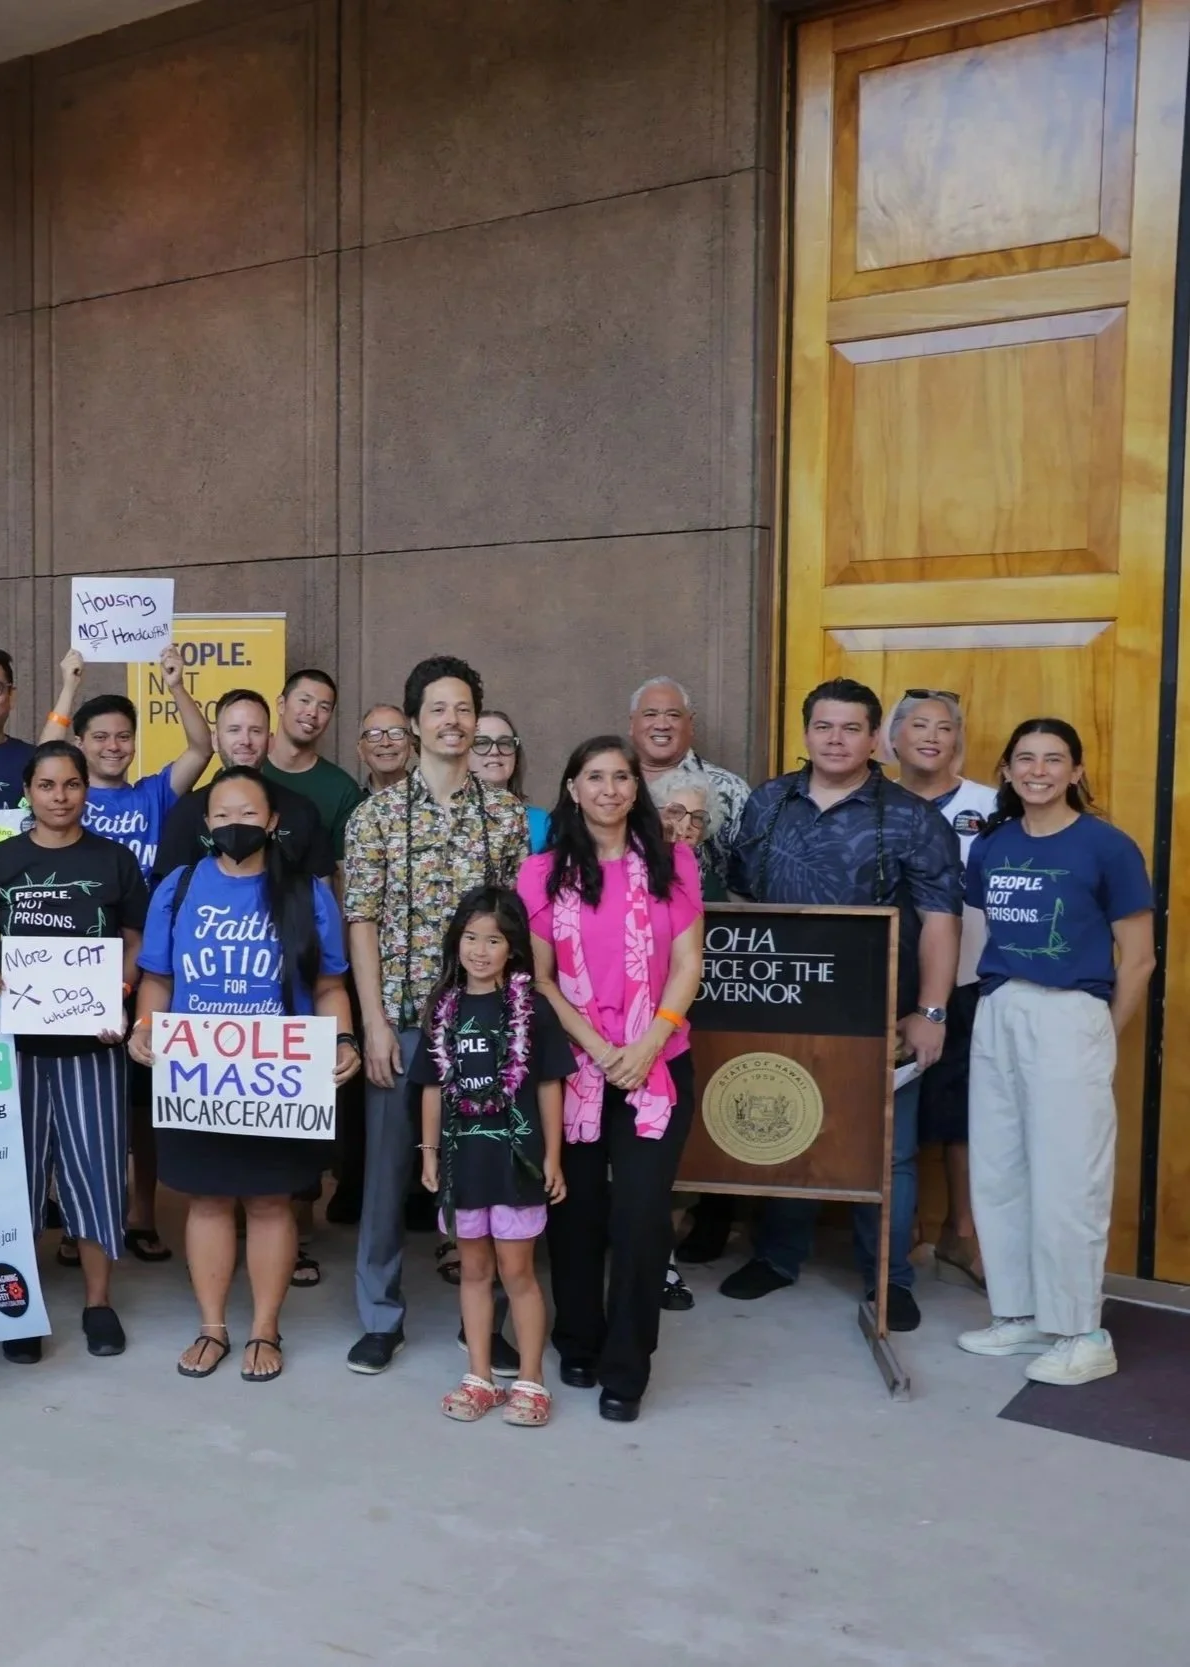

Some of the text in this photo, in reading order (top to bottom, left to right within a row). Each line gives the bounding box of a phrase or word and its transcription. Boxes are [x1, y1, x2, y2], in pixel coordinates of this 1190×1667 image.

[76, 592, 157, 617] Housing
[78, 620, 108, 639] NOT
[149, 671, 200, 695] NT
[81, 801, 148, 834] Faith
[990, 875, 1043, 891] PEOPLE.
[15, 890, 72, 901] PEOPLE.
[986, 890, 1013, 904] NOT
[14, 911, 77, 929] PRISONS.
[195, 905, 279, 943] Faith
[703, 926, 776, 953] OHA
[4, 945, 106, 972] More CAT
[750, 960, 783, 981] OF
[790, 961, 834, 983] THE
[52, 986, 94, 1006] Dog
[224, 979, 247, 994] FOR
[694, 981, 802, 1004] OVERNOR
[188, 994, 284, 1016] Community
[169, 1060, 302, 1098] MASS
[718, 1063, 749, 1086] STATE
[157, 1095, 334, 1132] INCARCERATION
[1, 1228, 18, 1247] jail
